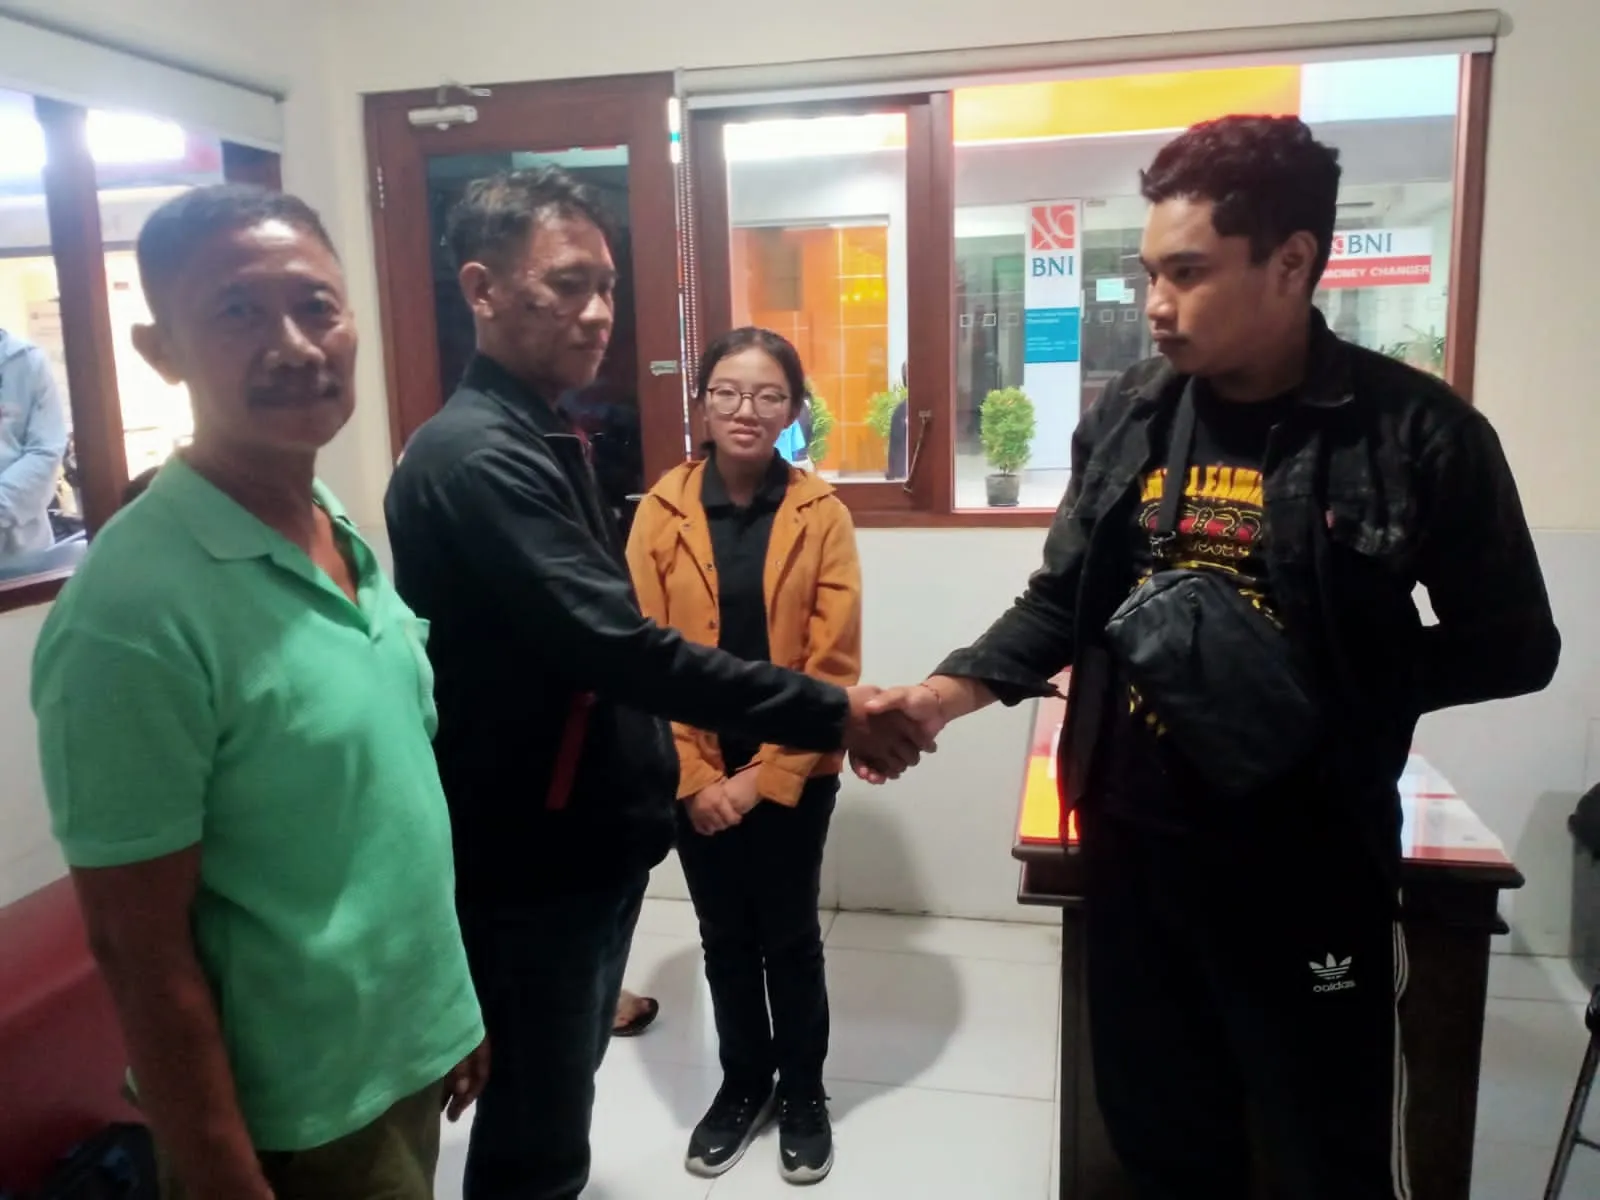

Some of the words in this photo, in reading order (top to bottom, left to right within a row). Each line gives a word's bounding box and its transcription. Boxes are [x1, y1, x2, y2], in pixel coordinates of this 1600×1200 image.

[1348, 233, 1391, 254] BNI
[1032, 256, 1073, 276] BNI
[1369, 264, 1431, 277] CHANGER
